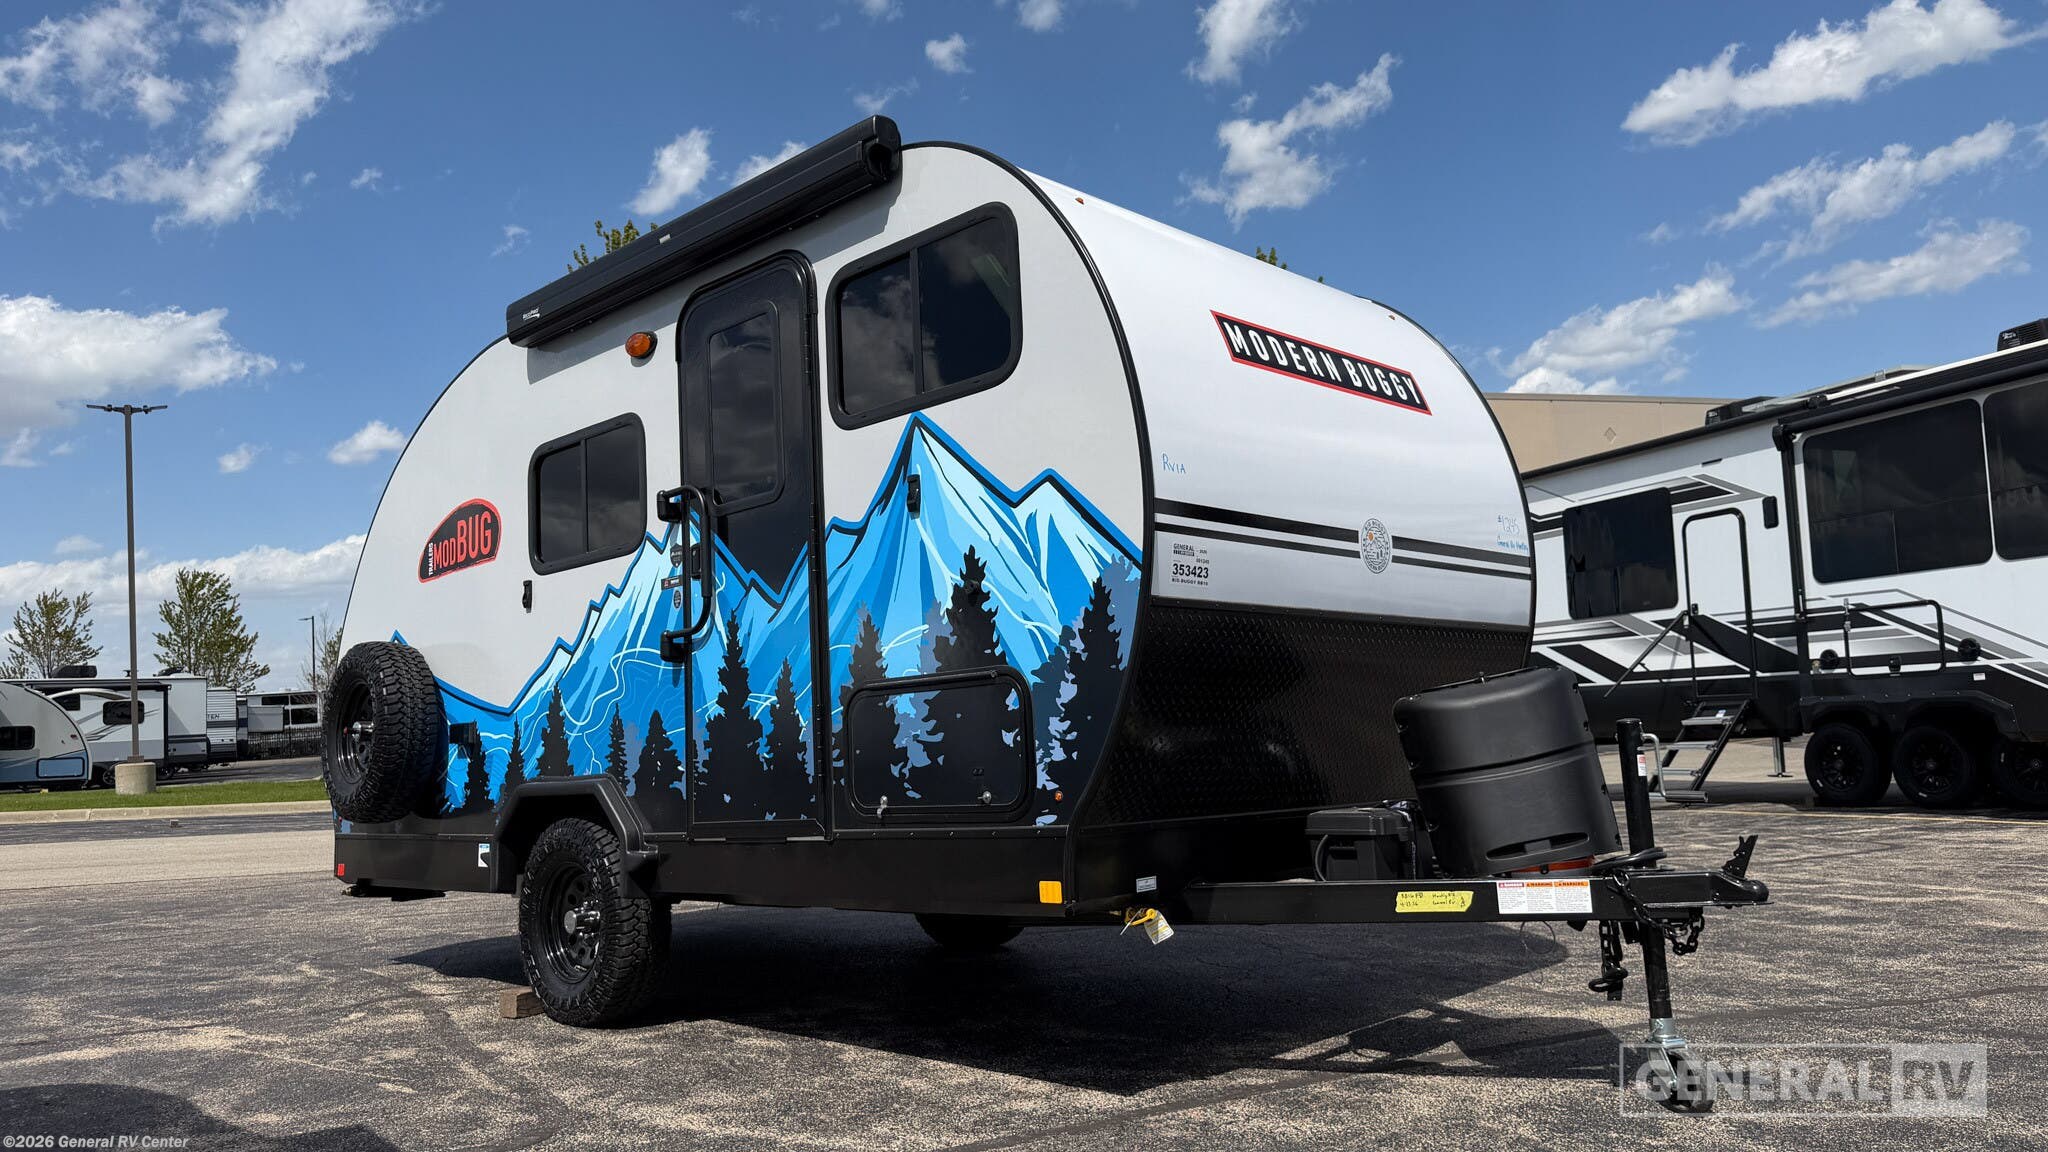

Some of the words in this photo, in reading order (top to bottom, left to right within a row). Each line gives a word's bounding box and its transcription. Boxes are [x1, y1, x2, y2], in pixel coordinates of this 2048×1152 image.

[1223, 321, 1342, 383] MODERN
[1341, 357, 1421, 404] BUGGY
[1173, 543, 1195, 552] GENERAL
[1172, 563, 1209, 578] 353423
